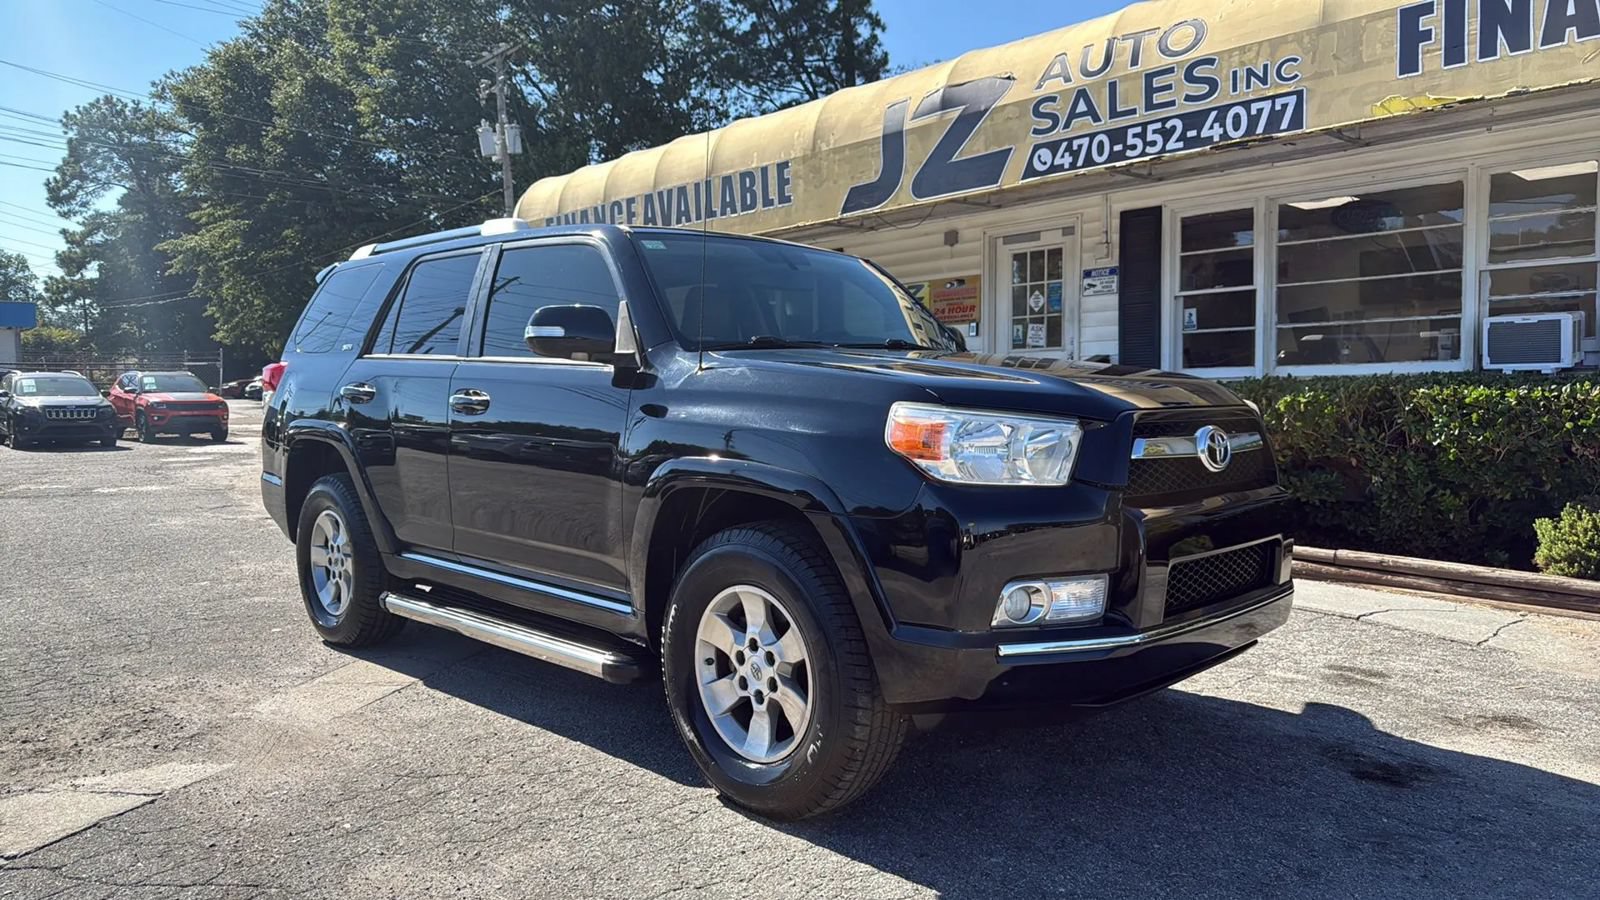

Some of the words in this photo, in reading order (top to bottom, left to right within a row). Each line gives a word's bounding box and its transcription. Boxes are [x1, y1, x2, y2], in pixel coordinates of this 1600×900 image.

[1034, 18, 1207, 91] AUTO
[1397, 0, 1600, 78] FINA
[1030, 57, 1220, 137] SALES
[1230, 56, 1302, 95] INC
[1053, 94, 1297, 170] 470-552-4077
[839, 76, 1015, 217] JZ
[545, 196, 637, 226] ANCE
[642, 160, 794, 227] AVAILABLE
[934, 307, 946, 315] 24
[947, 304, 977, 314] HOUR
